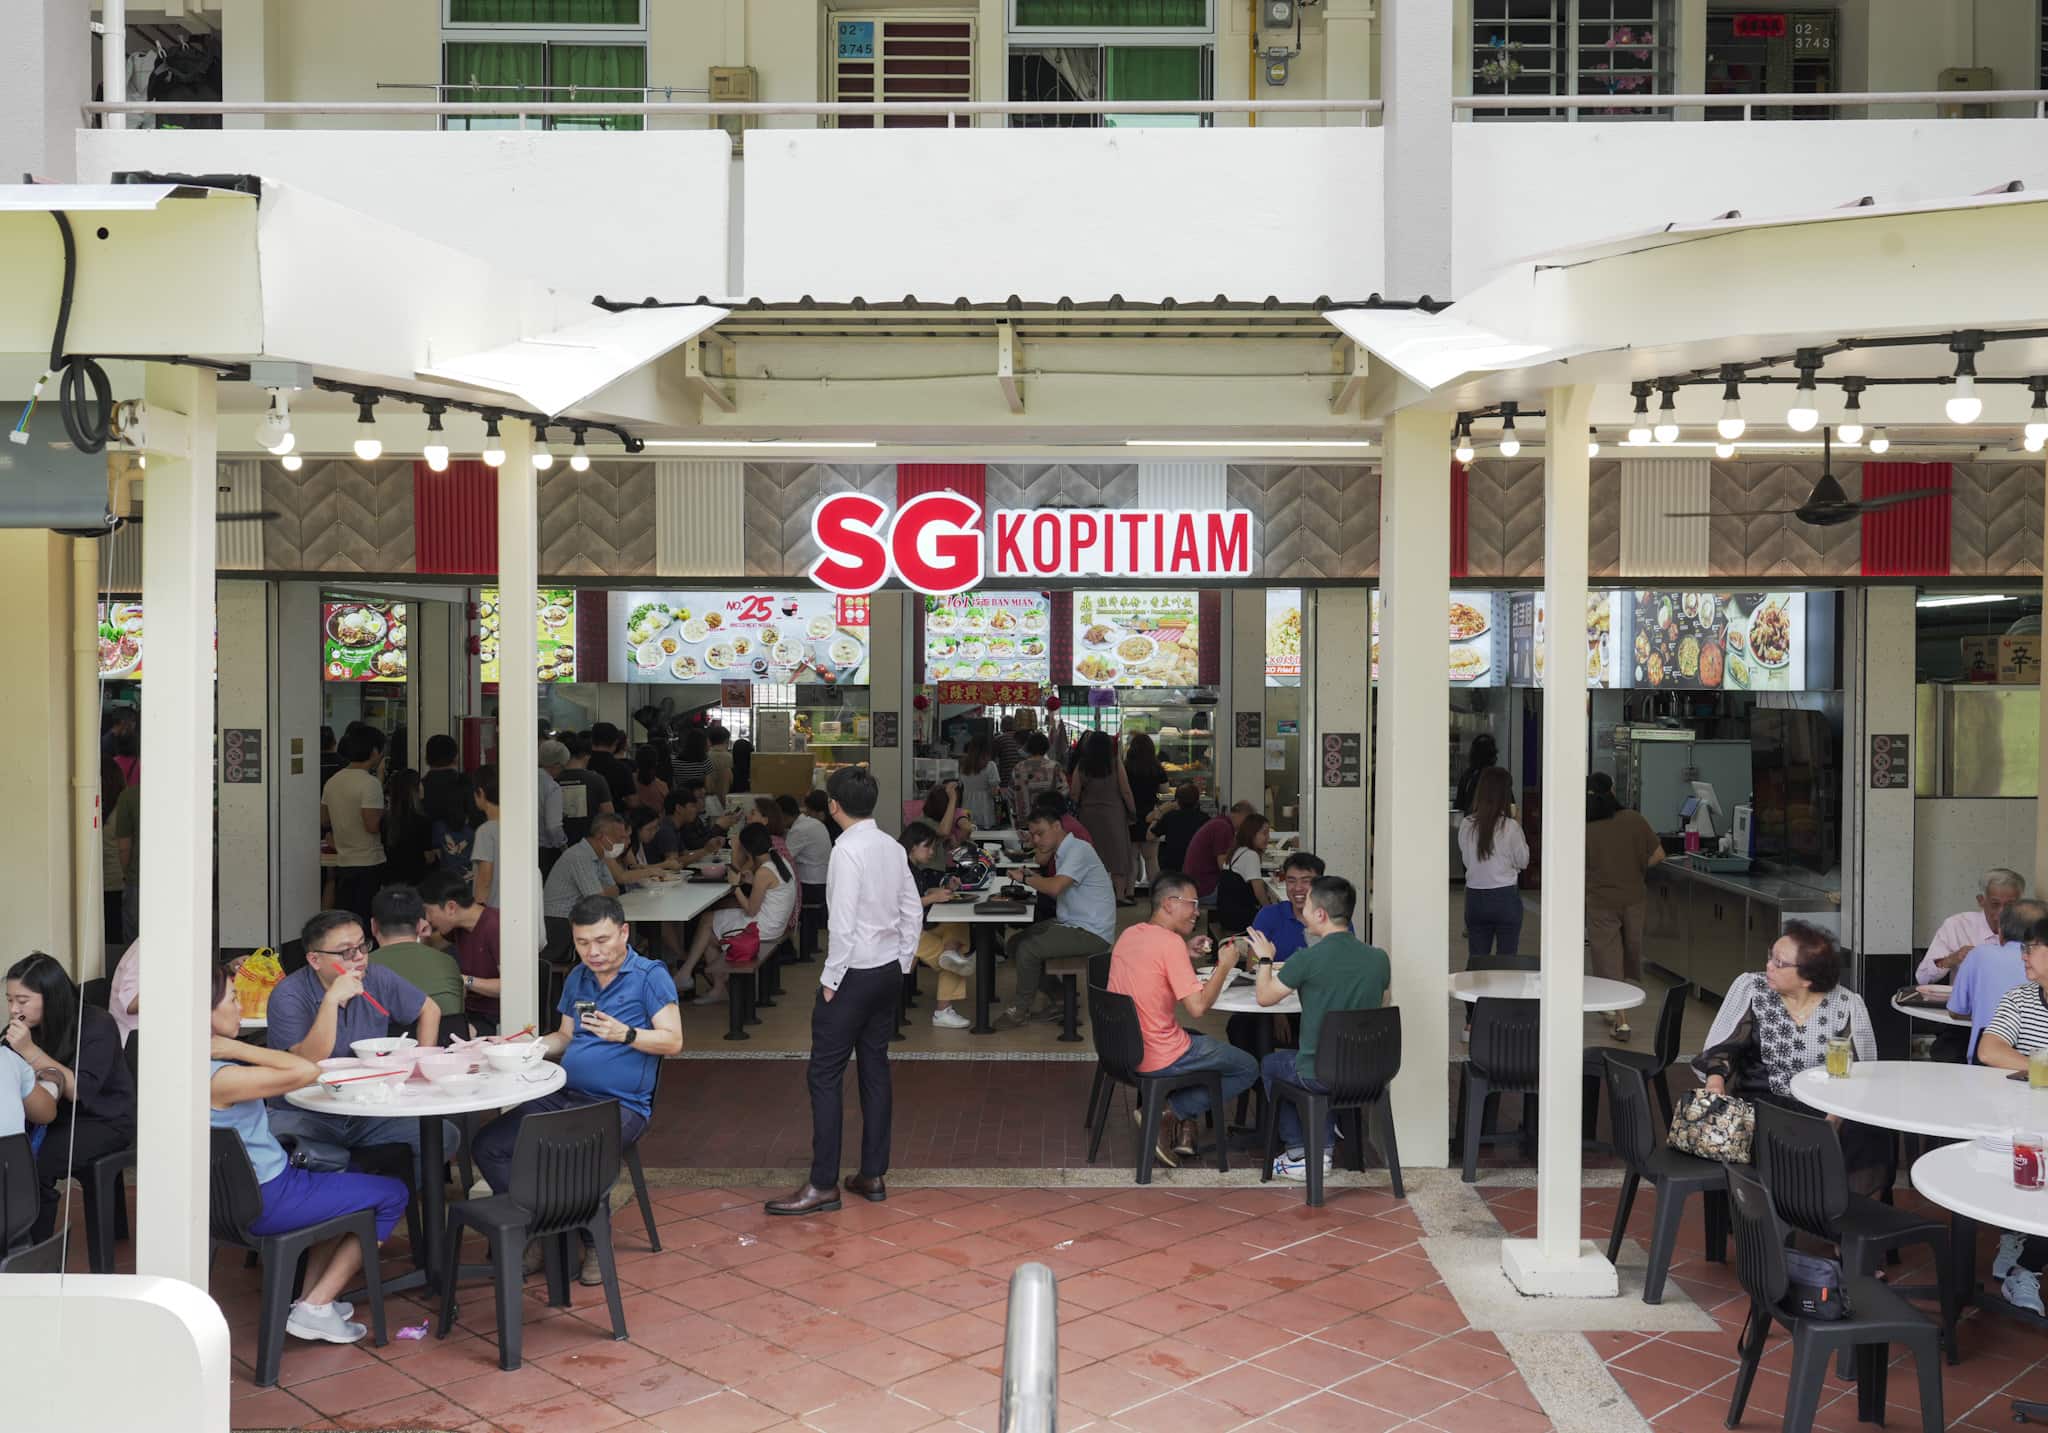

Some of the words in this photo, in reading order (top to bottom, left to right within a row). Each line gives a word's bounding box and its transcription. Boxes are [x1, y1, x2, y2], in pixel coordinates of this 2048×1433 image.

[840, 43, 872, 54] 3745
[1795, 38, 1830, 48] 3743
[811, 494, 982, 593] SG
[998, 512, 1249, 573] KOPITIAM
